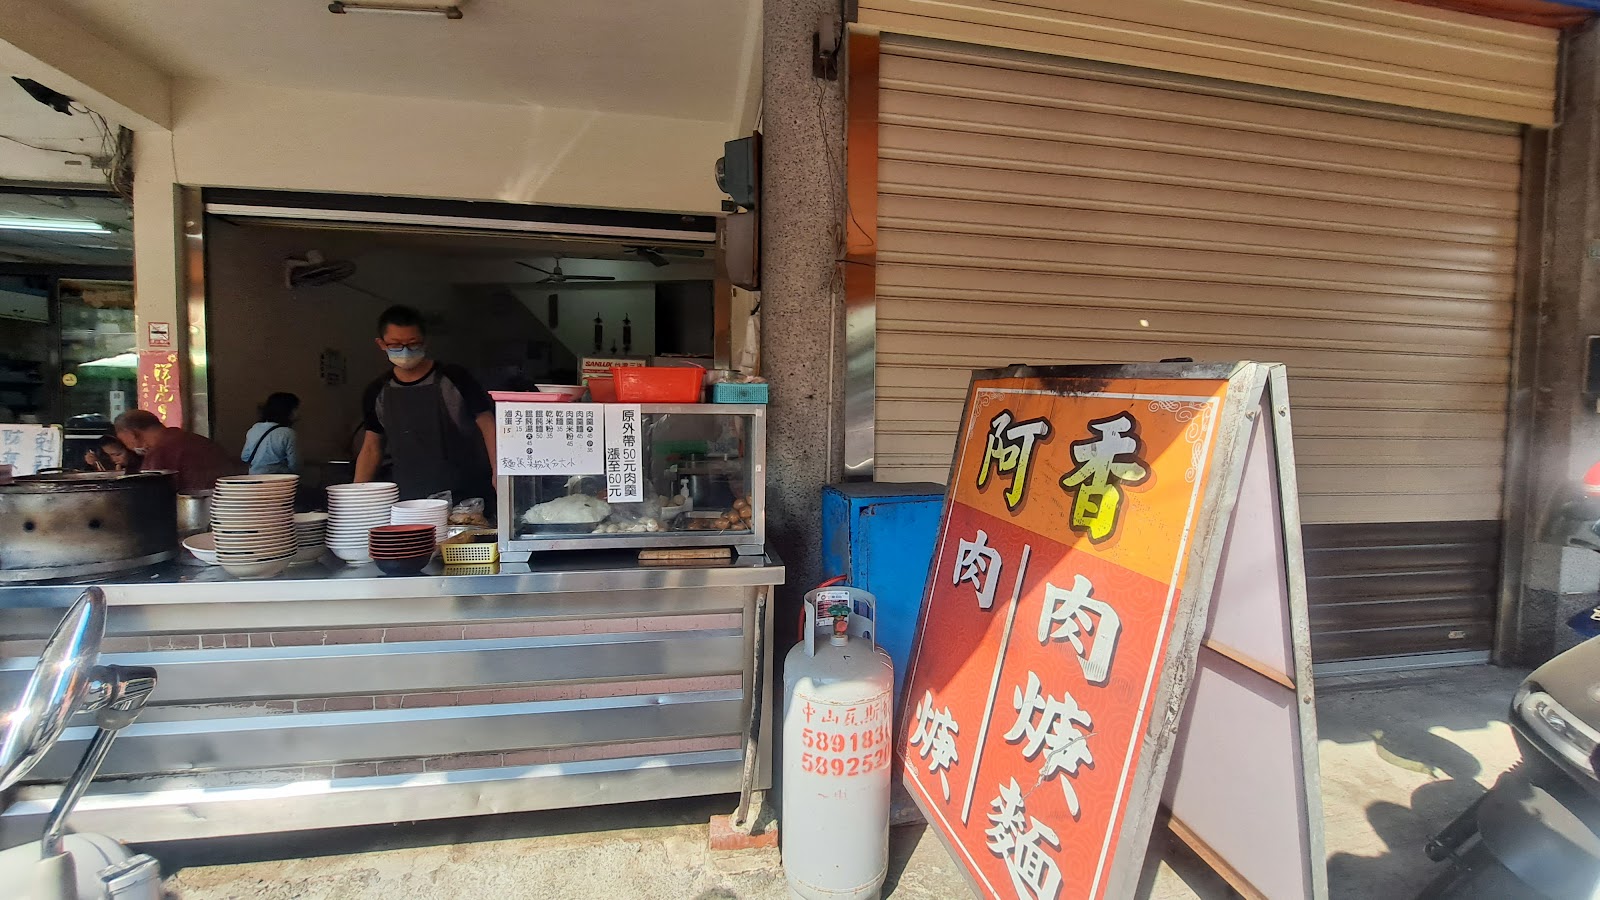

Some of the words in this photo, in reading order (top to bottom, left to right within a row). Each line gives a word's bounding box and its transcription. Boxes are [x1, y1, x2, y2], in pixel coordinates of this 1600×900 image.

[607, 448, 622, 497] 漲至60元
[976, 409, 1149, 540] 阿香
